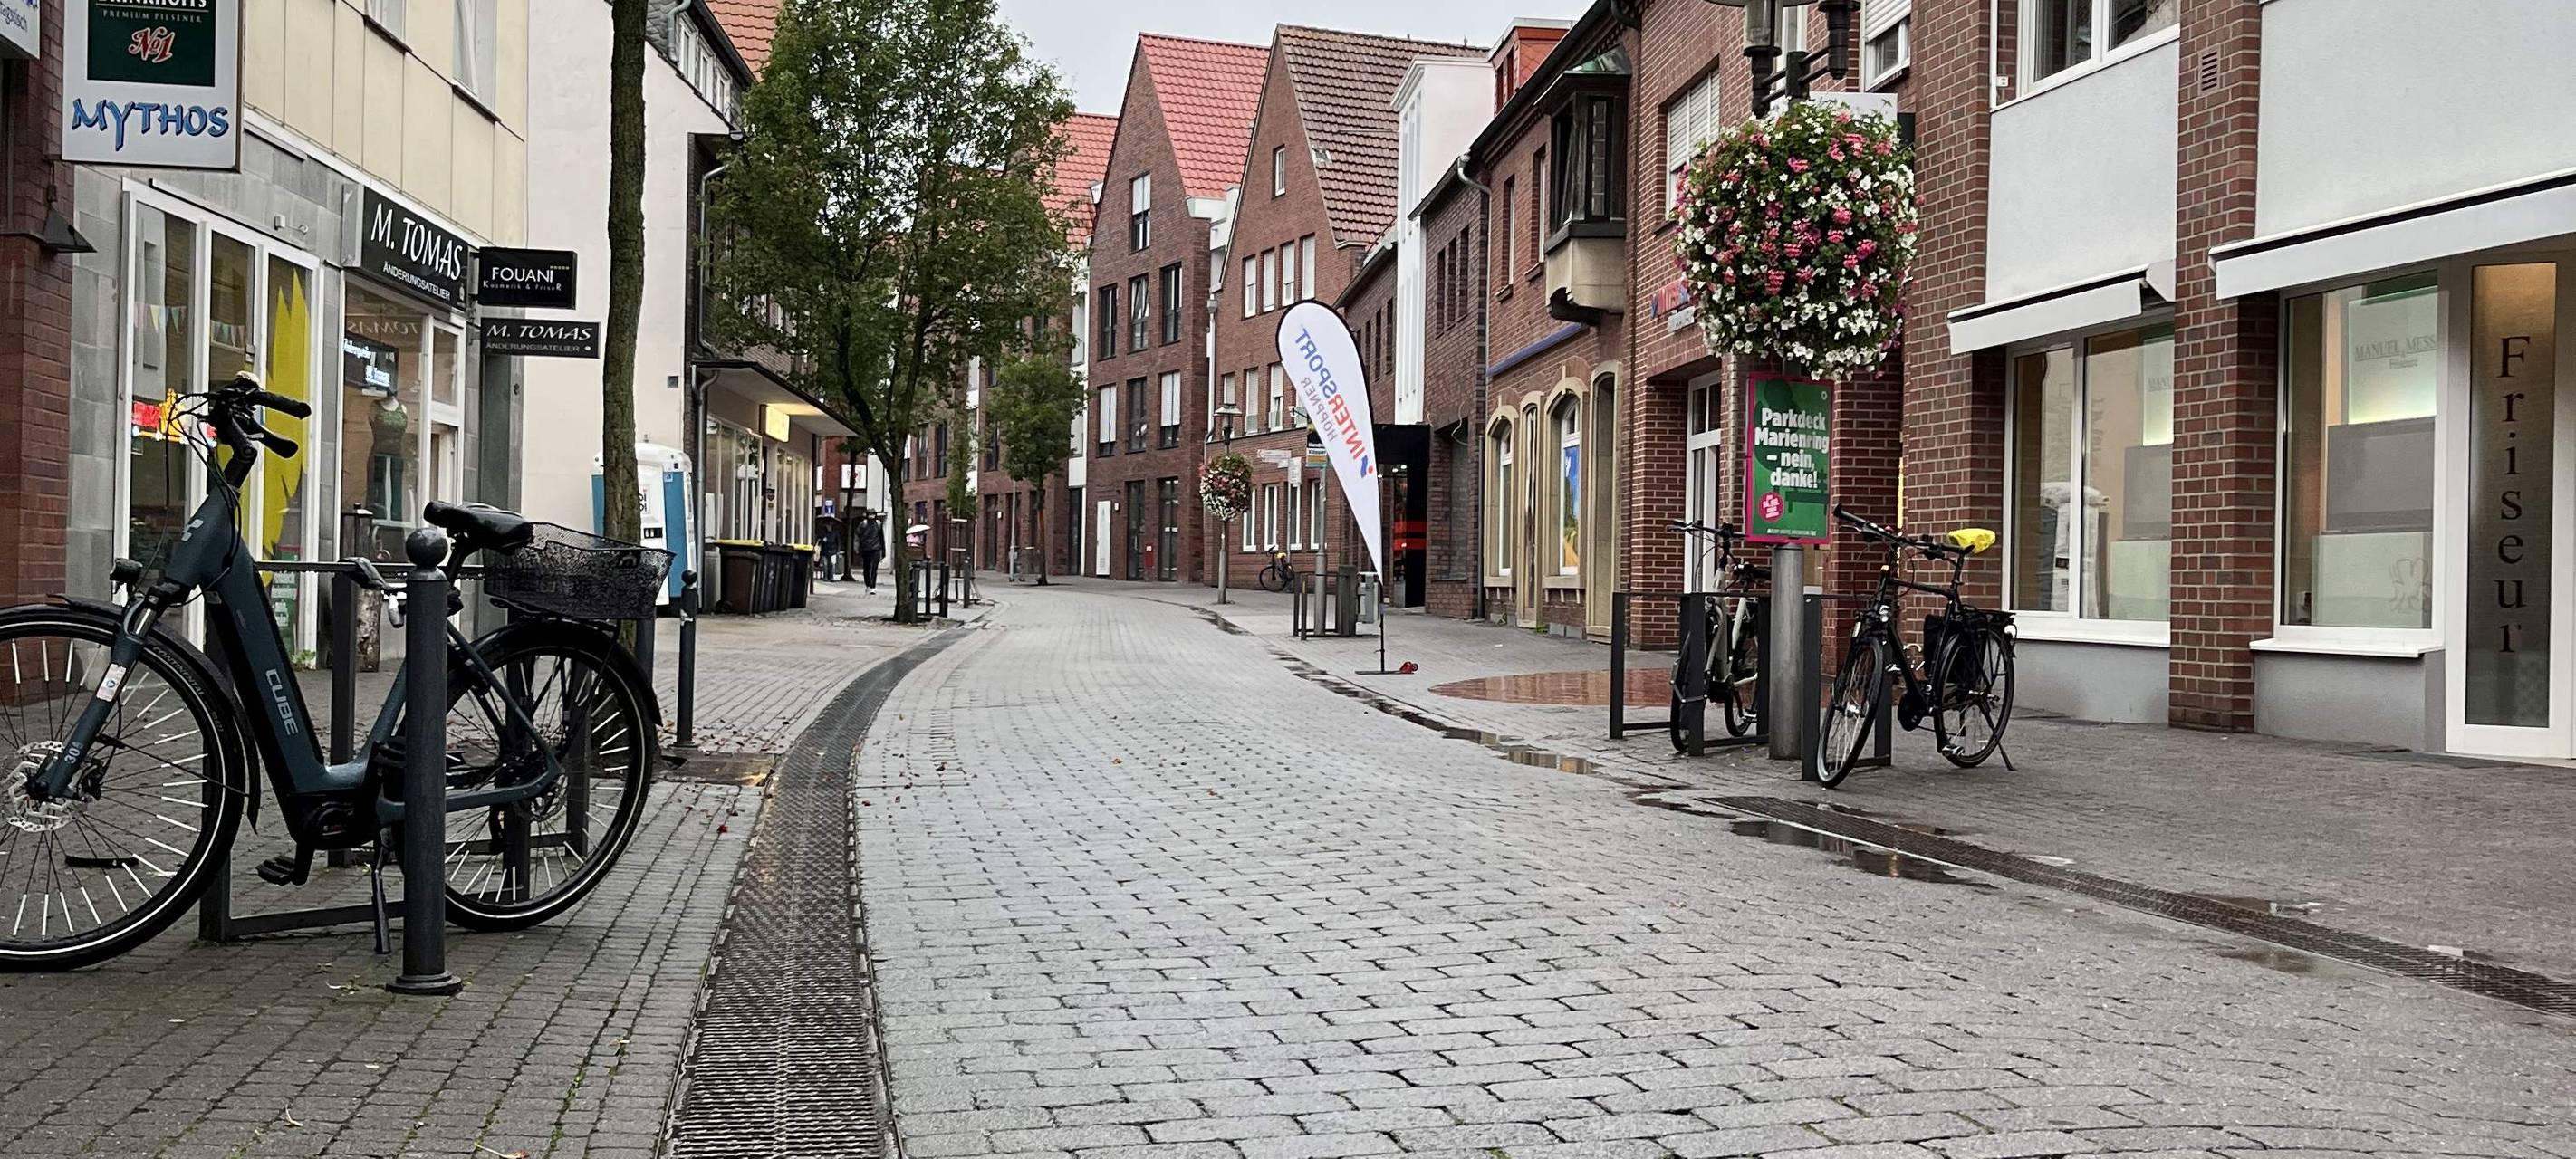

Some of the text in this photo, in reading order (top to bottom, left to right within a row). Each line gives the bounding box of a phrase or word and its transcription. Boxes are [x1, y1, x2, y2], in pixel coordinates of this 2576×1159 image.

[102, 9, 149, 19] PREMIUM
[72, 98, 230, 152] MYTHOS
[370, 203, 464, 281] M. TOMAS
[492, 267, 553, 283] FOUANI
[486, 325, 593, 340] M. TOMAS
[1761, 407, 1826, 431] Parkdeck
[1754, 426, 1830, 454] Marienring
[1781, 449, 1815, 471] nein,
[1770, 468, 1818, 489] danke!
[2494, 335, 2532, 654] Friseur
[265, 668, 299, 736] CUBE
